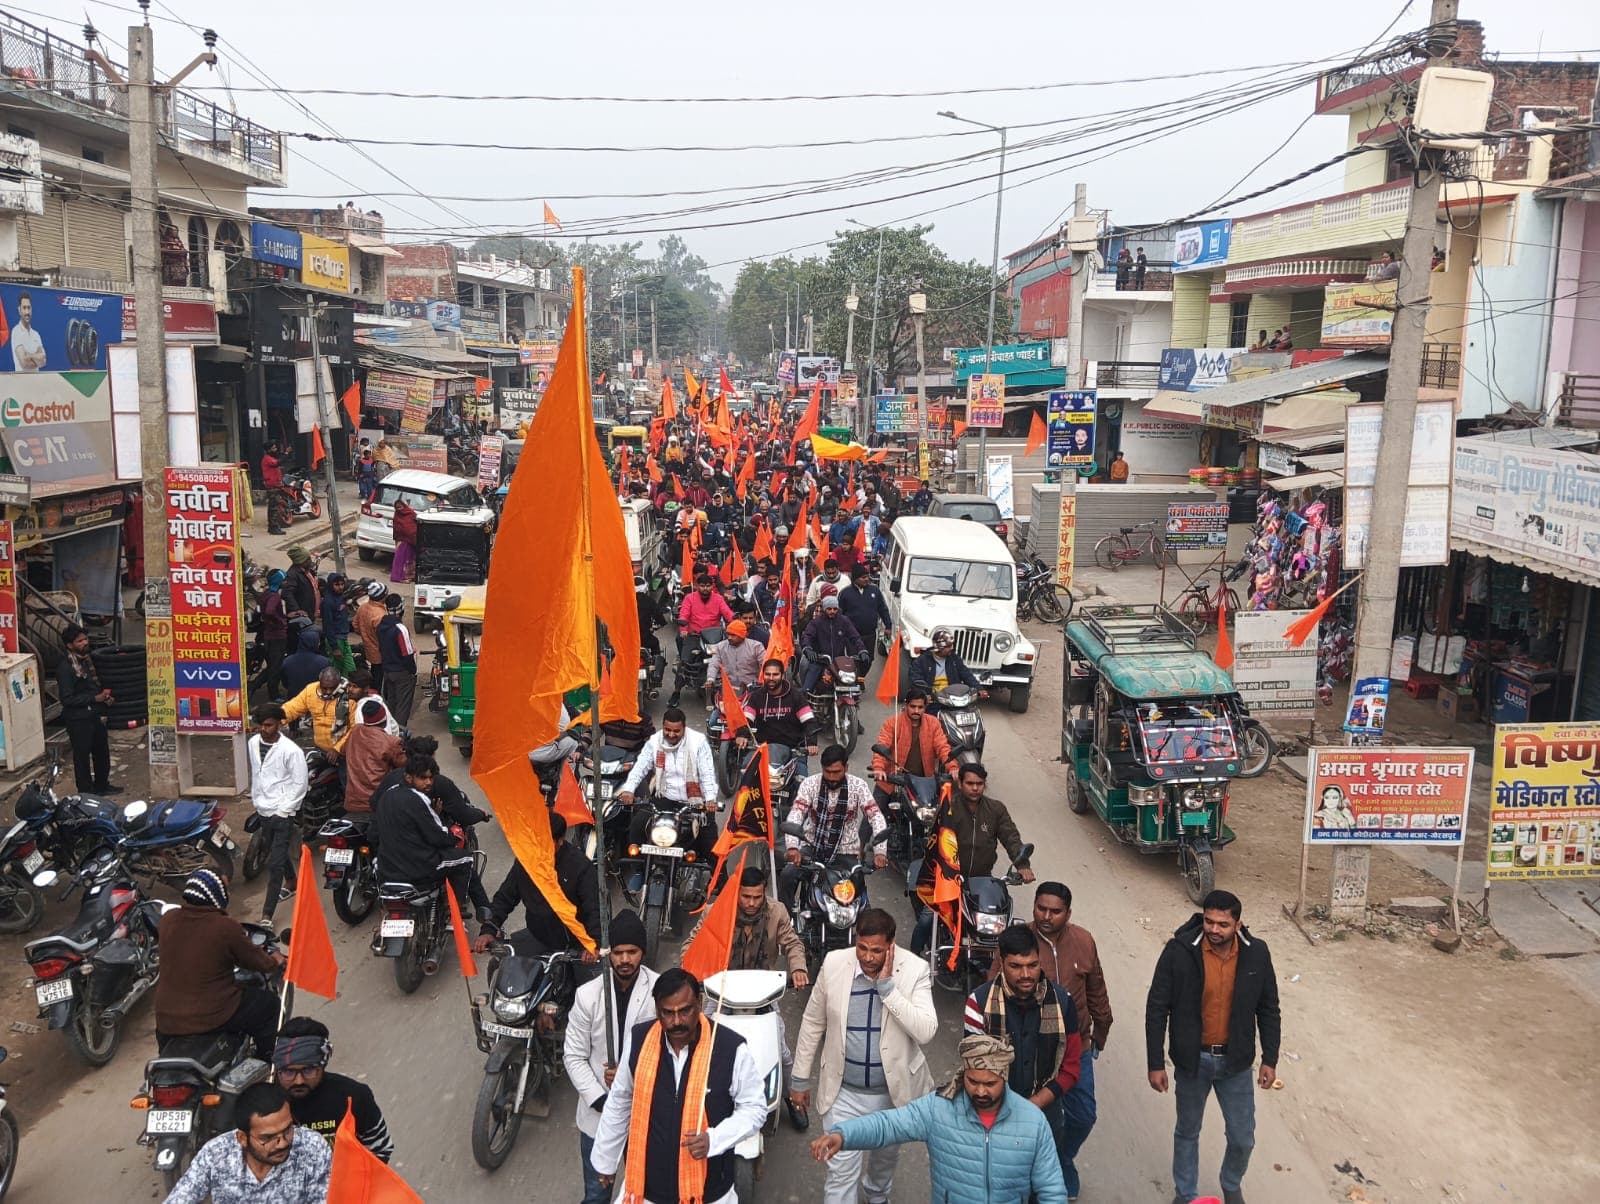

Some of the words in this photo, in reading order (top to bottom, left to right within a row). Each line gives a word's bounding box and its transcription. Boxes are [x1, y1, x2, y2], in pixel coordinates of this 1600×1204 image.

[263, 239, 298, 260] SAMSUNG
[309, 254, 344, 279] realme
[23, 400, 75, 424] Castrol
[885, 401, 911, 412] अमन
[13, 436, 69, 466] CEAT
[168, 485, 229, 512] नवीन
[168, 514, 232, 543] मोबाईल
[170, 565, 207, 585] लोन
[210, 569, 233, 585] पर
[184, 586, 222, 608] फोन
[175, 632, 189, 643] पर
[191, 630, 232, 644] मोबाईल
[183, 667, 232, 681] vivo
[1500, 733, 1600, 777] विष्णु
[1319, 762, 1367, 777] अमन
[1422, 762, 1465, 777] भवन
[1349, 780, 1371, 796] एवं
[1372, 783, 1413, 796] जनरल
[1416, 781, 1443, 796] स्टोर
[1495, 780, 1570, 808] मेडिकल
[1574, 778, 1600, 806] स्टो
[155, 1111, 187, 1122] UP53B
[311, 1119, 336, 1130] ASSN
[155, 1122, 186, 1132] C6421
